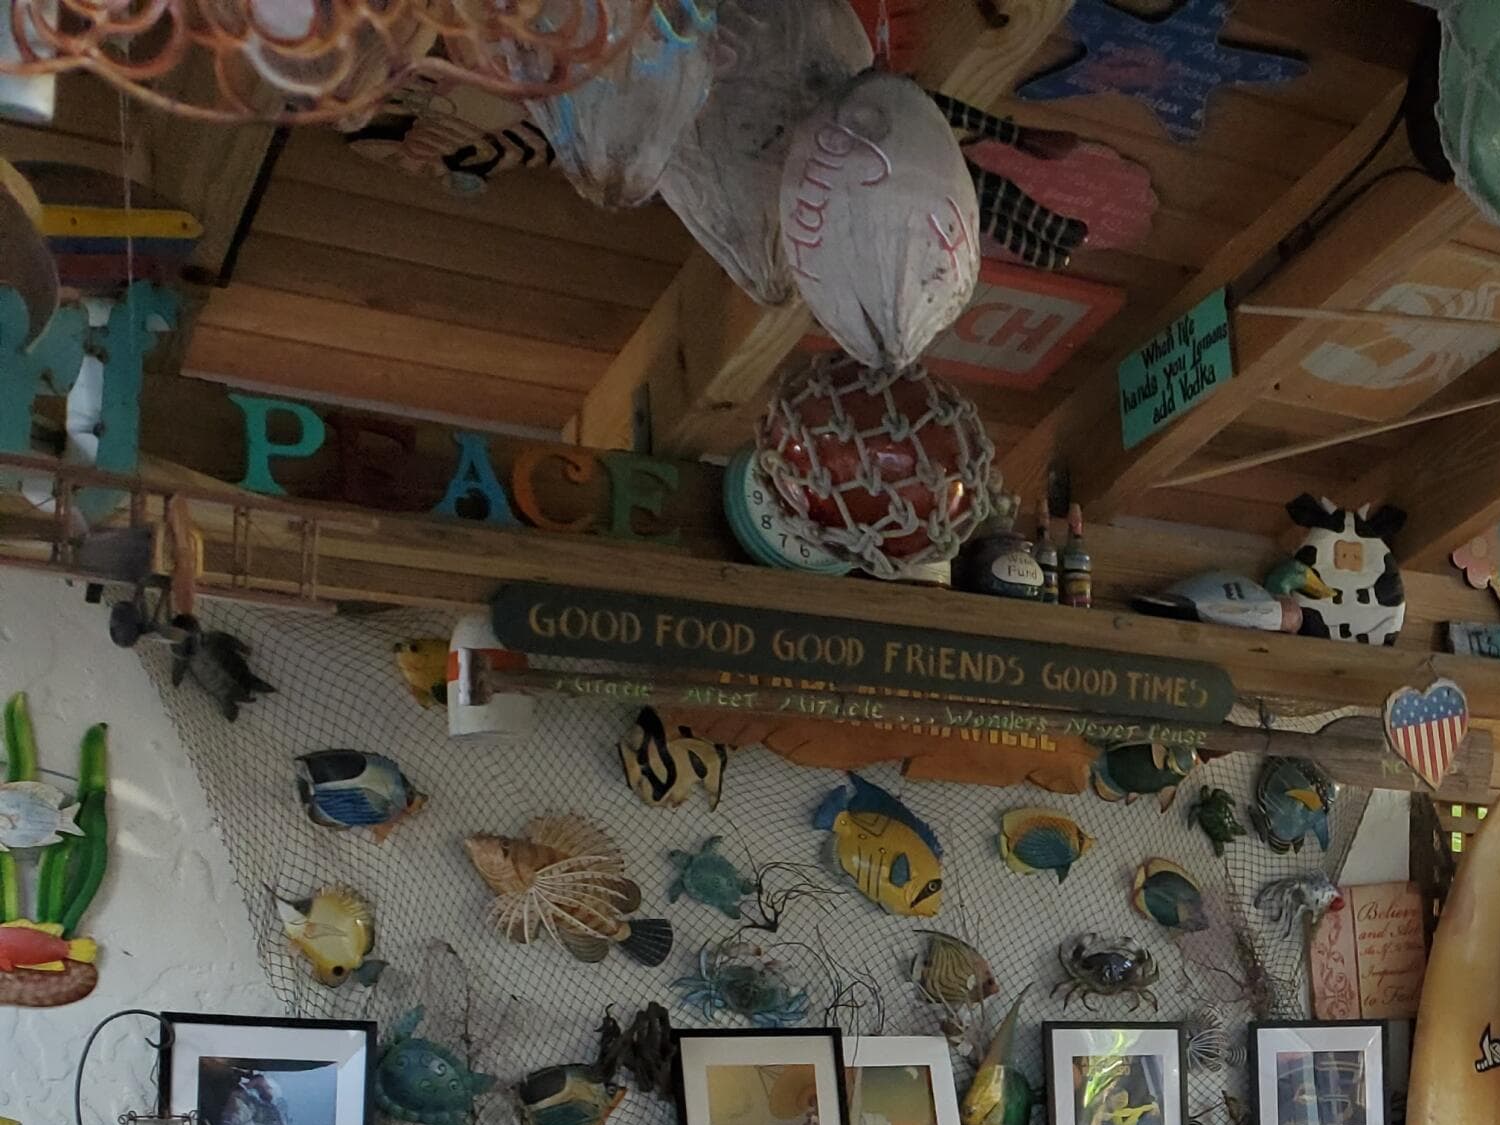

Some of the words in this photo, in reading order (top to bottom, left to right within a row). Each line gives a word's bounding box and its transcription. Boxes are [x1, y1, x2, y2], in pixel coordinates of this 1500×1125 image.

[787, 121, 892, 282] Hang
[1141, 326, 1175, 369] When
[1178, 314, 1195, 347] life
[1122, 373, 1158, 415] hands
[1163, 355, 1186, 390] you
[1153, 383, 1176, 424] add
[227, 392, 680, 545] PEACE
[761, 514, 772, 530] 8
[778, 533, 788, 548] 7
[800, 543, 810, 558] 6
[528, 602, 643, 645] GOOD
[655, 613, 756, 656] FOOD
[771, 628, 865, 667] GOOD
[1041, 660, 1118, 698] GOOD
[946, 706, 1048, 733] Wonders
[1064, 717, 1141, 741] Never
[1359, 920, 1390, 940] and
[1363, 994, 1378, 1007] to
